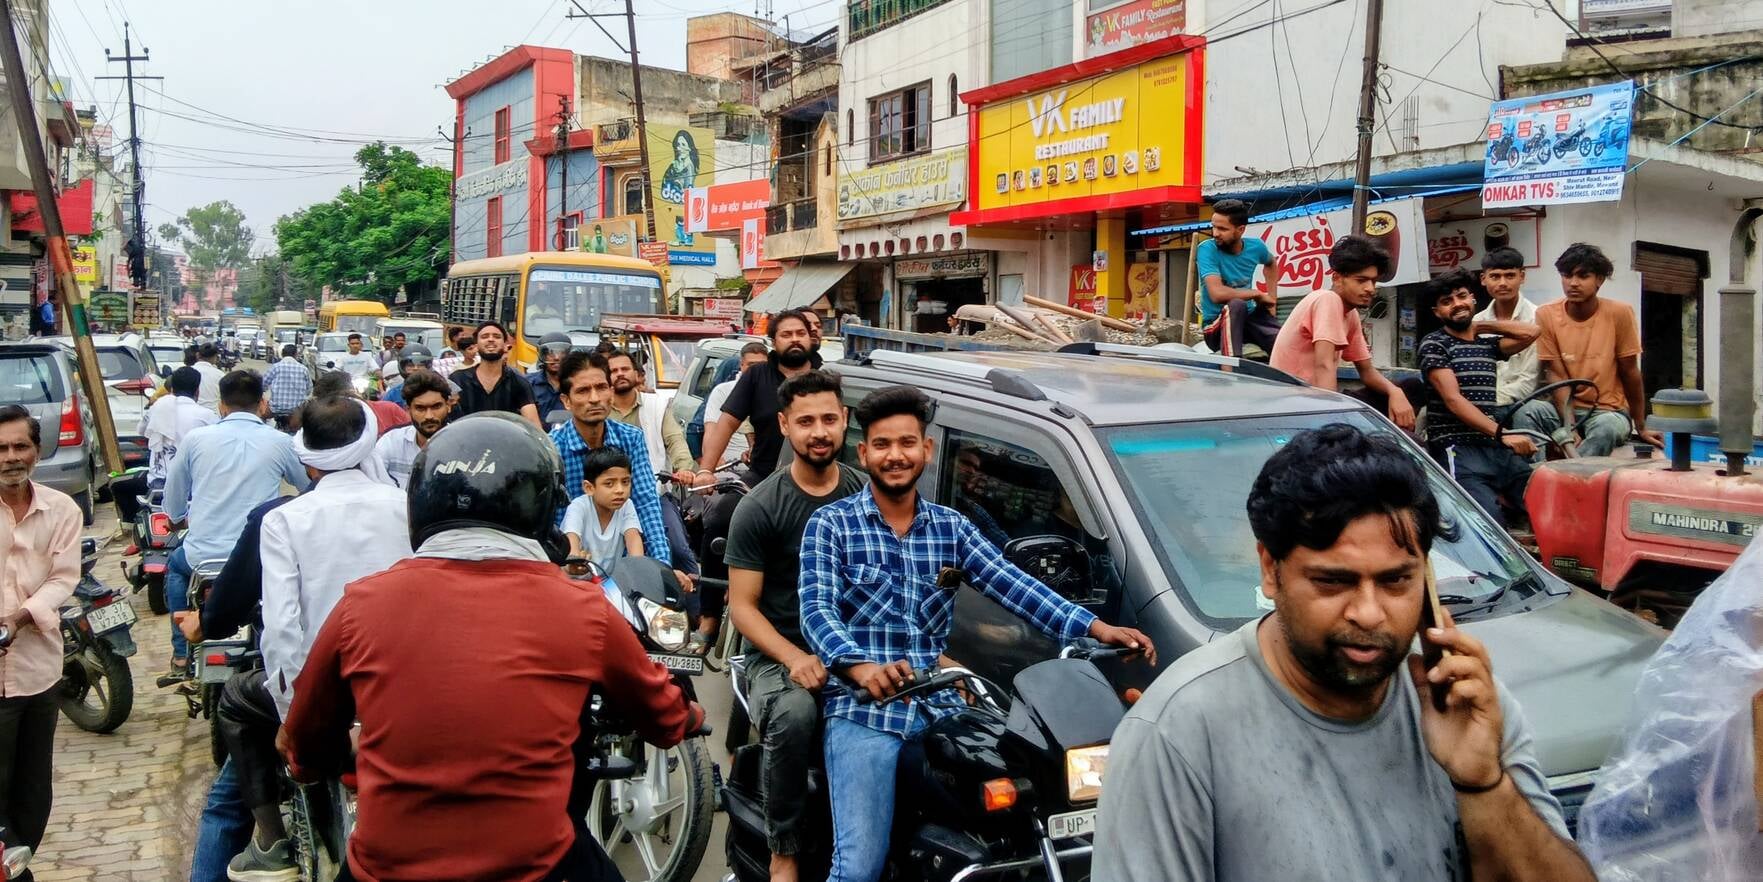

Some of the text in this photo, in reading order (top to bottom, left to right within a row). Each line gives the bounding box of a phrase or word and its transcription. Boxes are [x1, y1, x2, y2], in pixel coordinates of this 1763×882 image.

[1121, 9, 1146, 29] FAMILY
[1026, 89, 1126, 138] VK FAMILY
[1035, 133, 1110, 160] RESTAURANT
[1484, 182, 1554, 202] OMKAR TVS
[597, 273, 626, 284] PUBLIC
[433, 449, 495, 476] NINJA
[1653, 512, 1729, 534] MAHINDRA
[95, 608, 106, 620] UP
